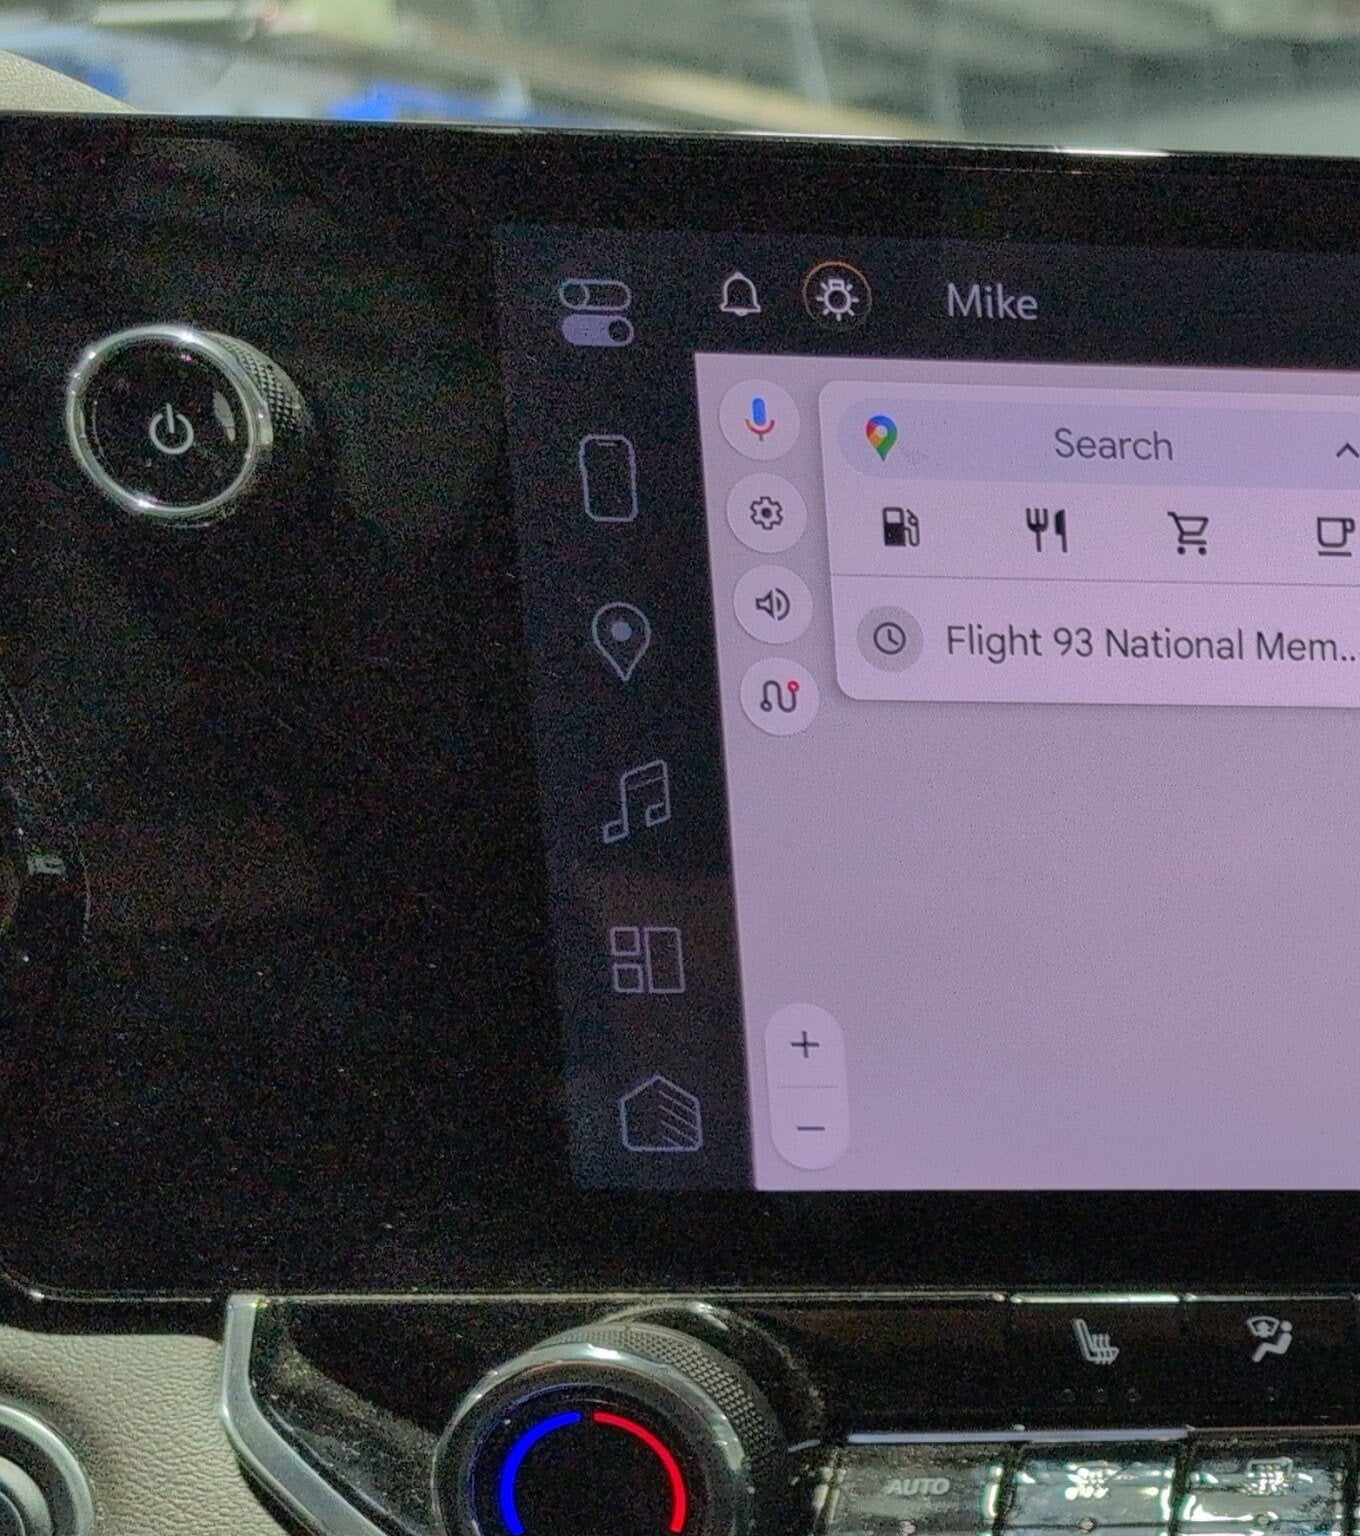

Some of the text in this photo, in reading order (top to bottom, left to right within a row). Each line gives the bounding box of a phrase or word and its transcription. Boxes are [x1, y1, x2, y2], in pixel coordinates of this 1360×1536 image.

[947, 282, 1038, 320] Mike
[1054, 427, 1174, 461] Search
[946, 624, 1043, 664] Flight
[1053, 627, 1093, 658] 93
[1106, 628, 1244, 661] National
[884, 1477, 951, 1496] AUTO
